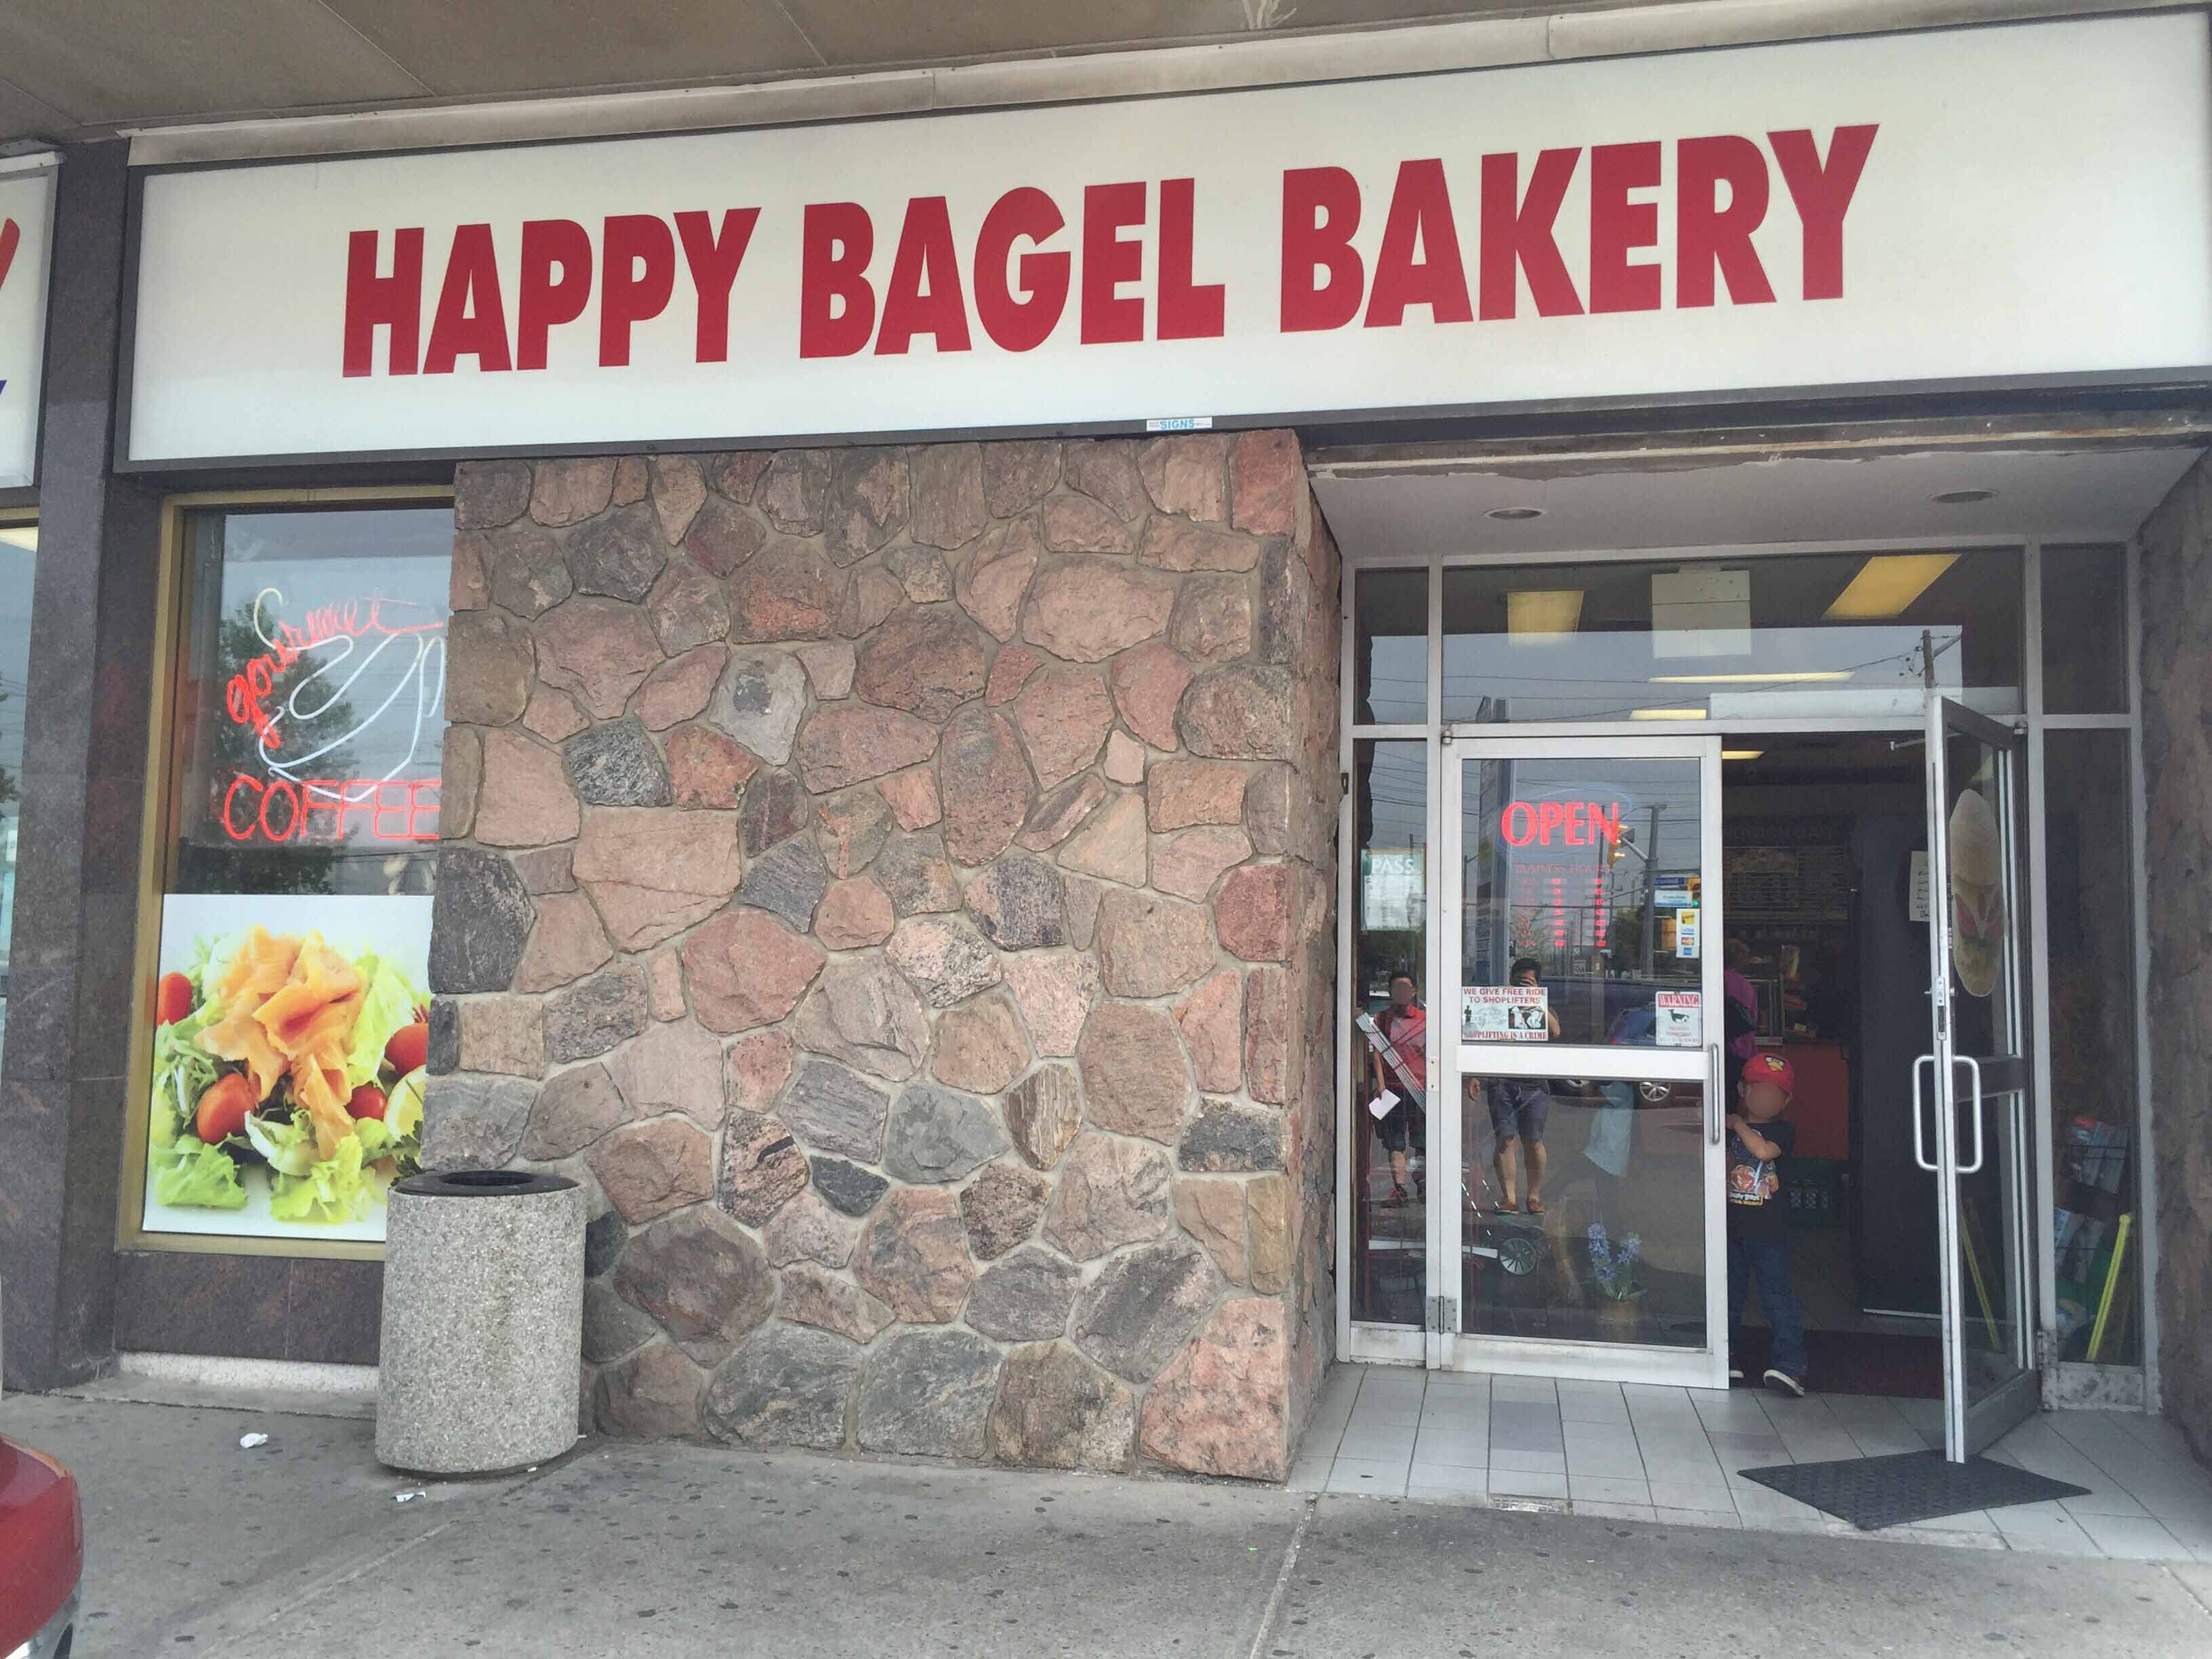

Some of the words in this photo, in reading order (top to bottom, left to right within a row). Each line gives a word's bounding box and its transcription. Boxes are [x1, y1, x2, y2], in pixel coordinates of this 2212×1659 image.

[342, 206, 762, 378] HAPPY
[800, 177, 1225, 359] BAGEL
[1279, 123, 1880, 333] BAKERY
[1160, 419, 1194, 430] SIGNS
[224, 773, 442, 841] COFFEE
[1501, 801, 1619, 846] OPEN
[1371, 857, 1415, 874] PASS
[1515, 863, 1565, 874] BUSINESS
[1658, 994, 1699, 1007] WARNING
[1510, 1031, 1517, 1040] IS
[1518, 1031, 1523, 1040] A
[1525, 1031, 1546, 1040] CRIME
